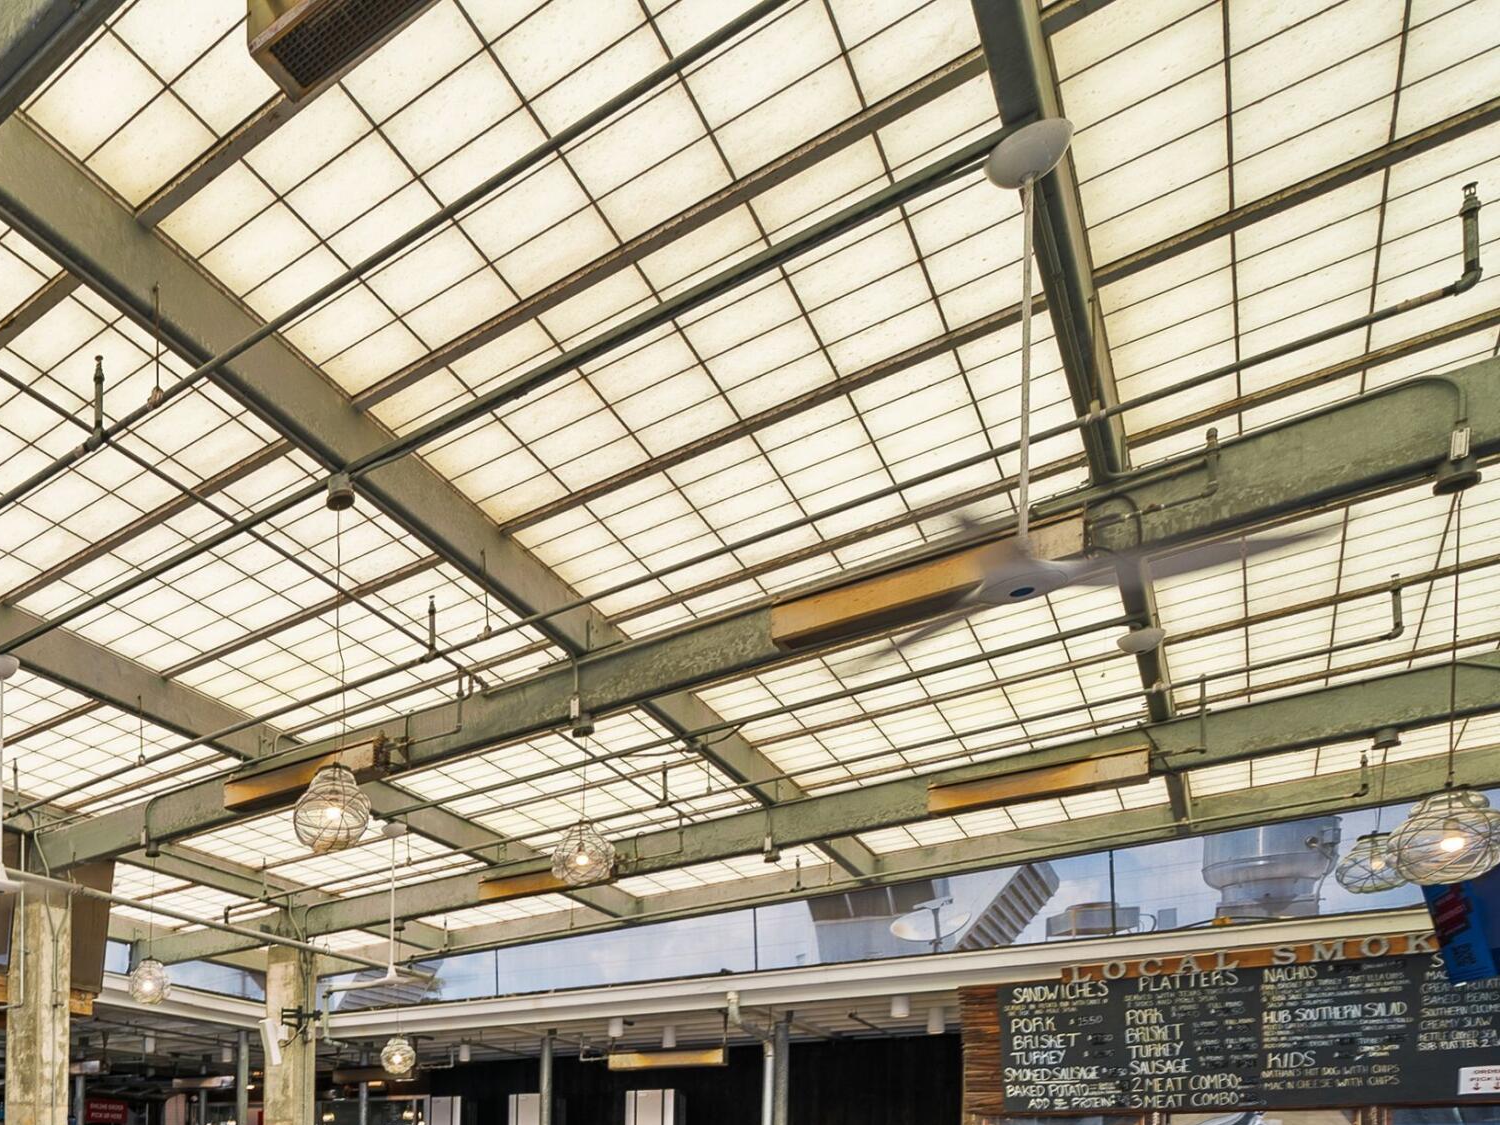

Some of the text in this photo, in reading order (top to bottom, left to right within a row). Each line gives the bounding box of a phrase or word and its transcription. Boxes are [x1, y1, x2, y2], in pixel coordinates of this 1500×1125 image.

[1070, 950, 1240, 983] LOCAL
[1263, 965, 1318, 983] NACHOS
[1138, 969, 1240, 993] PLATTERS
[1012, 979, 1109, 1004] SANDWICHES
[1421, 993, 1461, 1006] BAKED
[1125, 1008, 1165, 1026] PORK
[1262, 1010, 1292, 1024] HUB
[1294, 1003, 1362, 1022] SOUTHERN
[1363, 1001, 1408, 1018] SALAD
[1420, 1005, 1468, 1018] SOUTHERN
[1011, 1016, 1057, 1034] PORK
[1420, 1018, 1460, 1031] CREAMY
[1463, 1016, 1492, 1028] SLAW
[1012, 1032, 1082, 1052] BRISKET
[1125, 1023, 1185, 1044] BRISKET
[1010, 1049, 1067, 1067] TURKEY
[1126, 1041, 1184, 1060] TURKEY
[1266, 1050, 1317, 1069] KIDS
[1003, 1067, 1051, 1083] SMOKED
[1051, 1065, 1101, 1081] SAUSAGE
[1129, 1057, 1192, 1076] SAUSAGE
[1322, 1066, 1340, 1076] DOG
[1343, 1065, 1369, 1075] WITH
[1371, 1063, 1400, 1074] CHIPS
[1006, 1084, 1045, 1098] BAKED
[1047, 1083, 1090, 1098] POTATO
[1132, 1076, 1144, 1092] 2
[1145, 1075, 1188, 1092] MEAT
[1264, 1081, 1284, 1090] MAC
[1297, 1078, 1333, 1089] CHEESE
[1337, 1077, 1363, 1087] WITH
[1367, 1075, 1400, 1086] CHIPS
[1027, 1097, 1051, 1110] ADD
[1130, 1094, 1143, 1109] 3
[1144, 1093, 1187, 1109] MEAT
